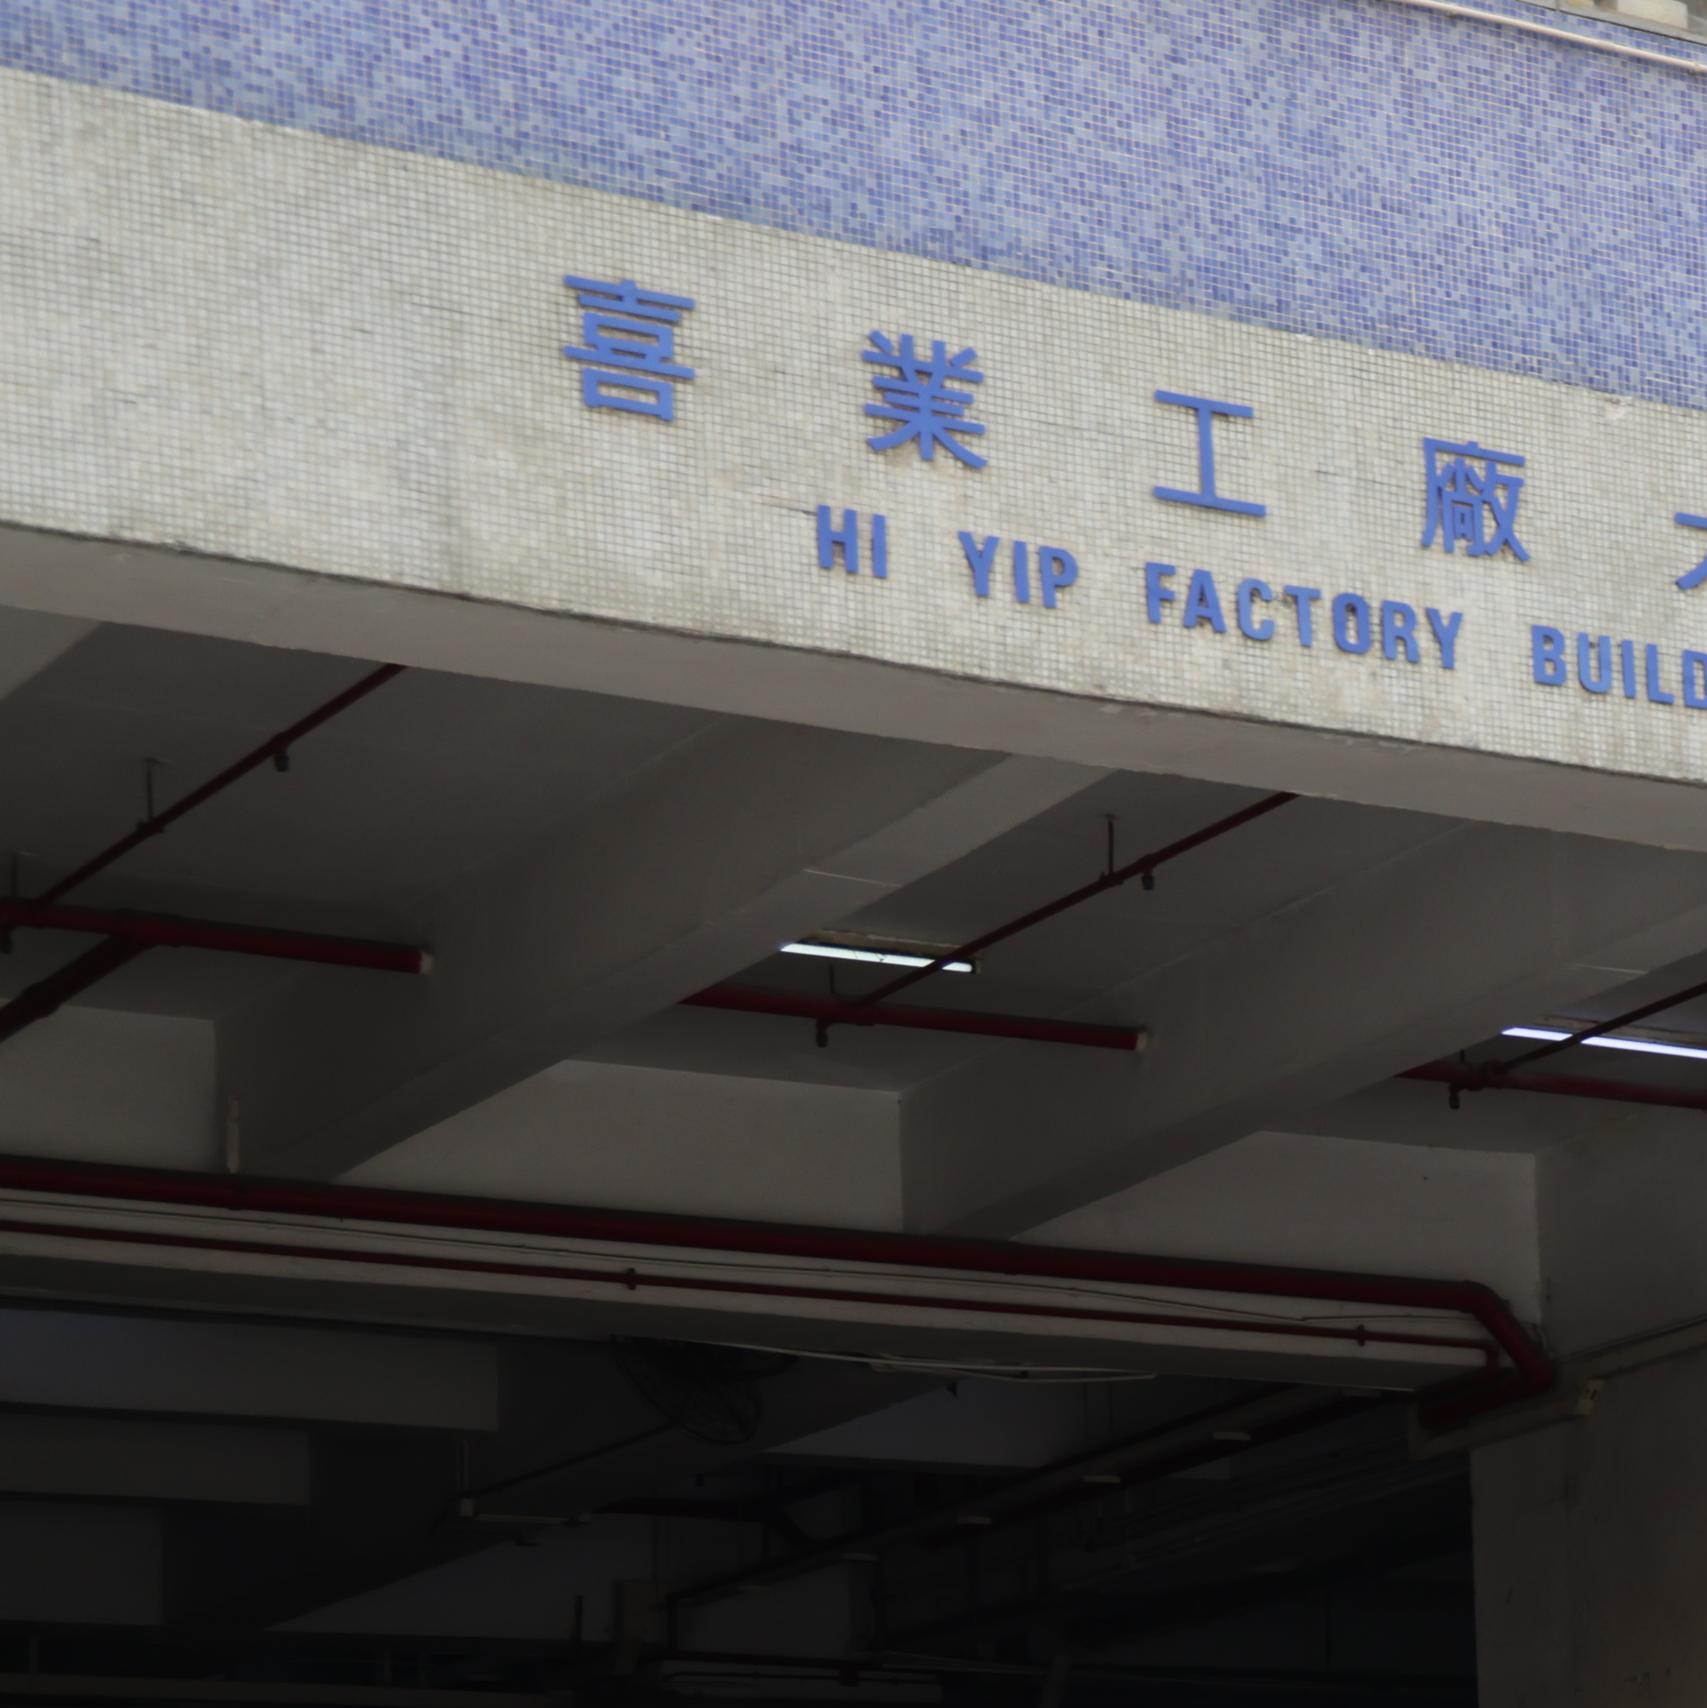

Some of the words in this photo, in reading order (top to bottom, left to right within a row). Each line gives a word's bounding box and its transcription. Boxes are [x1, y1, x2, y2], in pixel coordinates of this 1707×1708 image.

[813, 503, 888, 580] HI
[957, 529, 1079, 610] YIP
[1143, 561, 1465, 673] FACTORY
